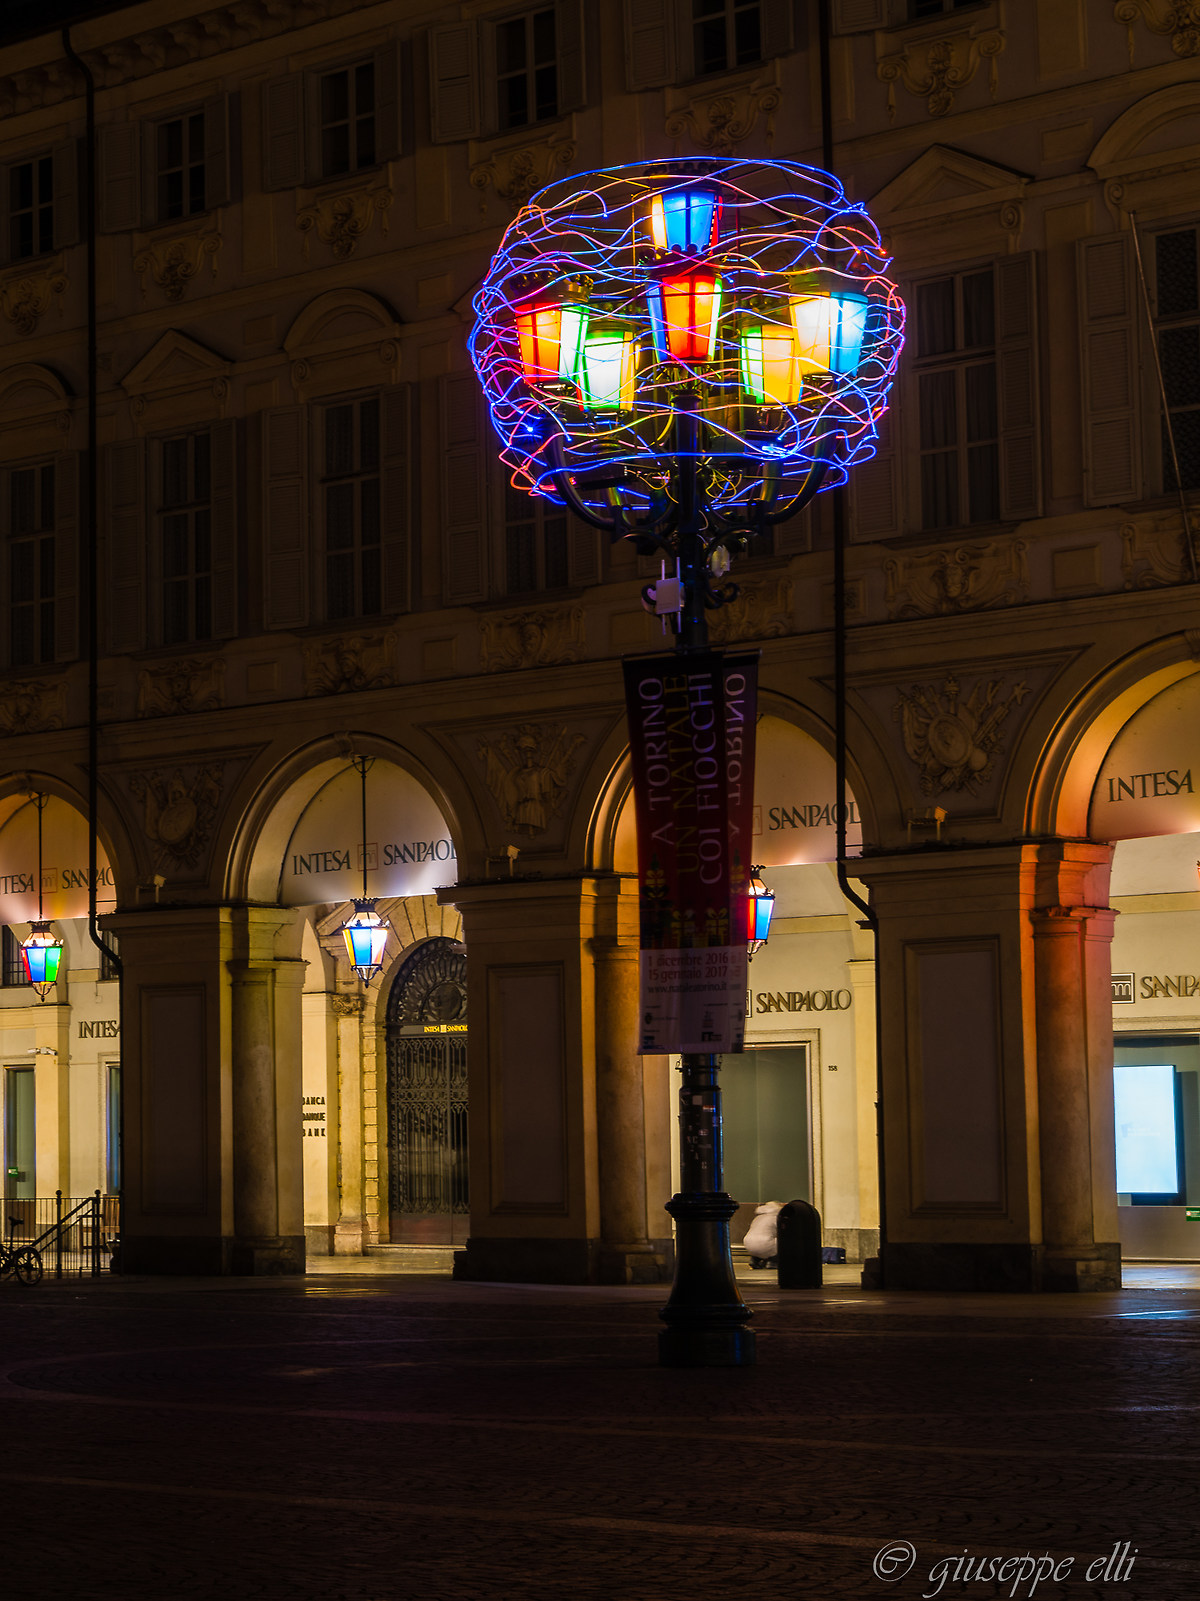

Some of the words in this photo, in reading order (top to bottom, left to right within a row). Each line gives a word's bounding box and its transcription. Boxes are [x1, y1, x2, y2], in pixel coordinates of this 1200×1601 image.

[638, 677, 672, 811] TORINO
[663, 673, 697, 812] NATALE
[687, 673, 721, 814] FIOCCHI
[1108, 769, 1195, 803] INTESA
[293, 850, 352, 875] INTESA
[674, 825, 701, 875] UN
[699, 827, 723, 885] COI
[648, 969, 659, 980] 15
[660, 967, 701, 983] gennaio
[705, 966, 728, 978] 2017
[657, 953, 702, 967] dicembre
[705, 953, 728, 965] 2016
[756, 988, 852, 1014] SANPAOLO
